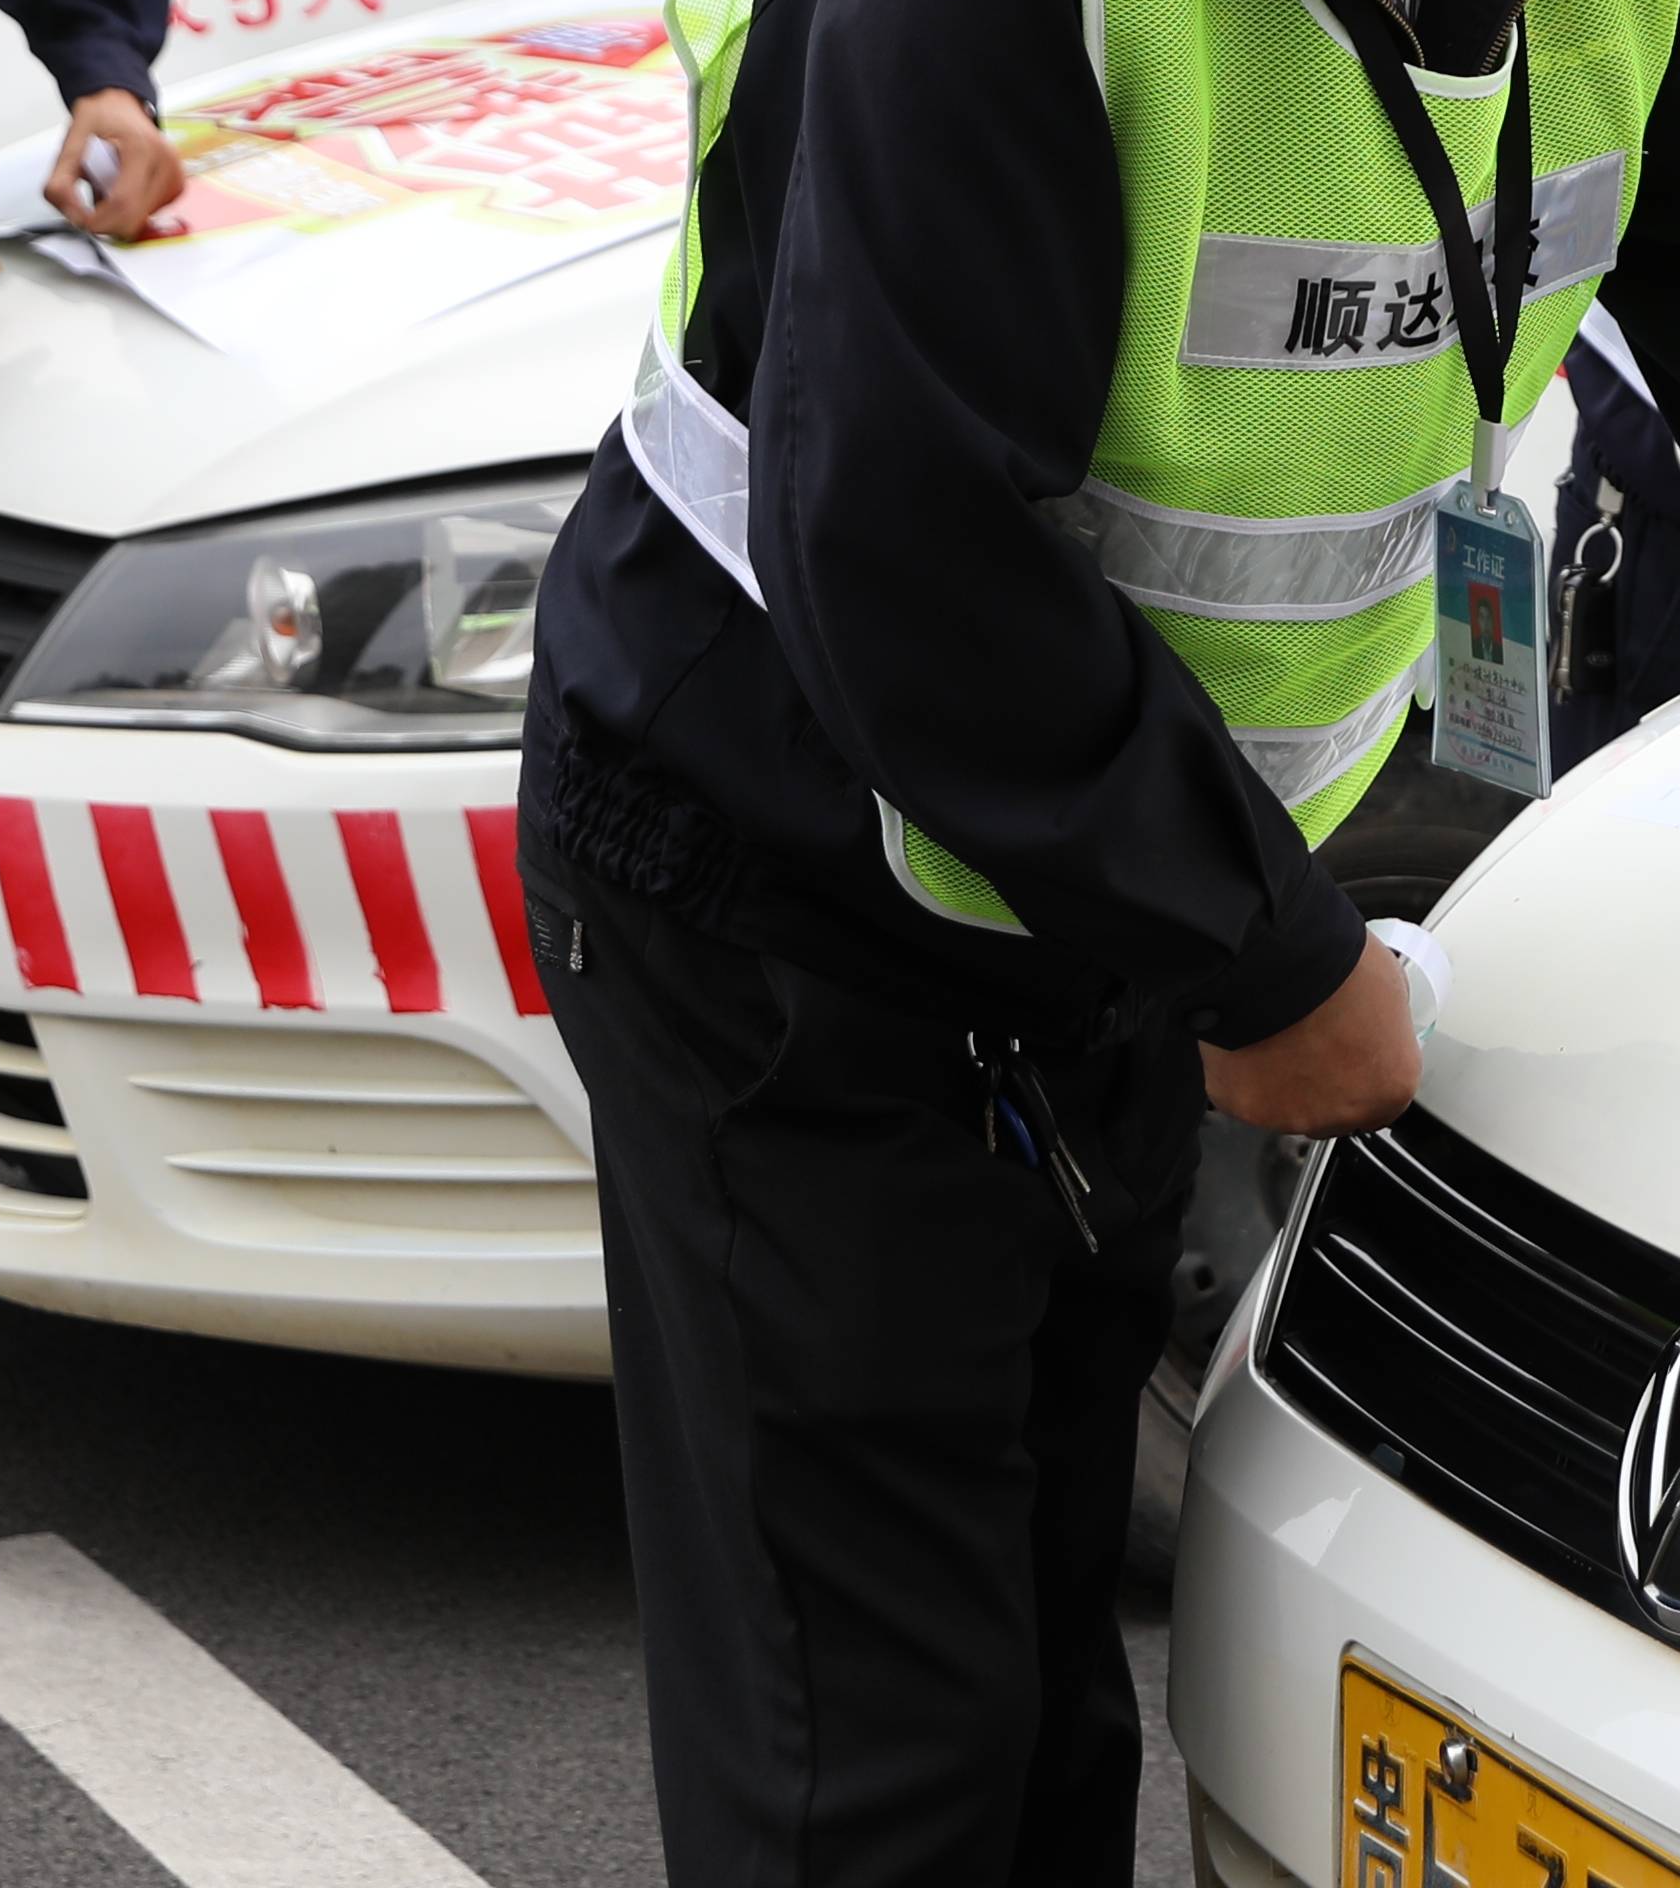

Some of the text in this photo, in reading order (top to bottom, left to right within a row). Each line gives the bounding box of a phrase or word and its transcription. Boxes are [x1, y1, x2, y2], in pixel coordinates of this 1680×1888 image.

[1285, 217, 1543, 358] 顺达
[1461, 544, 1506, 581] 工作证
